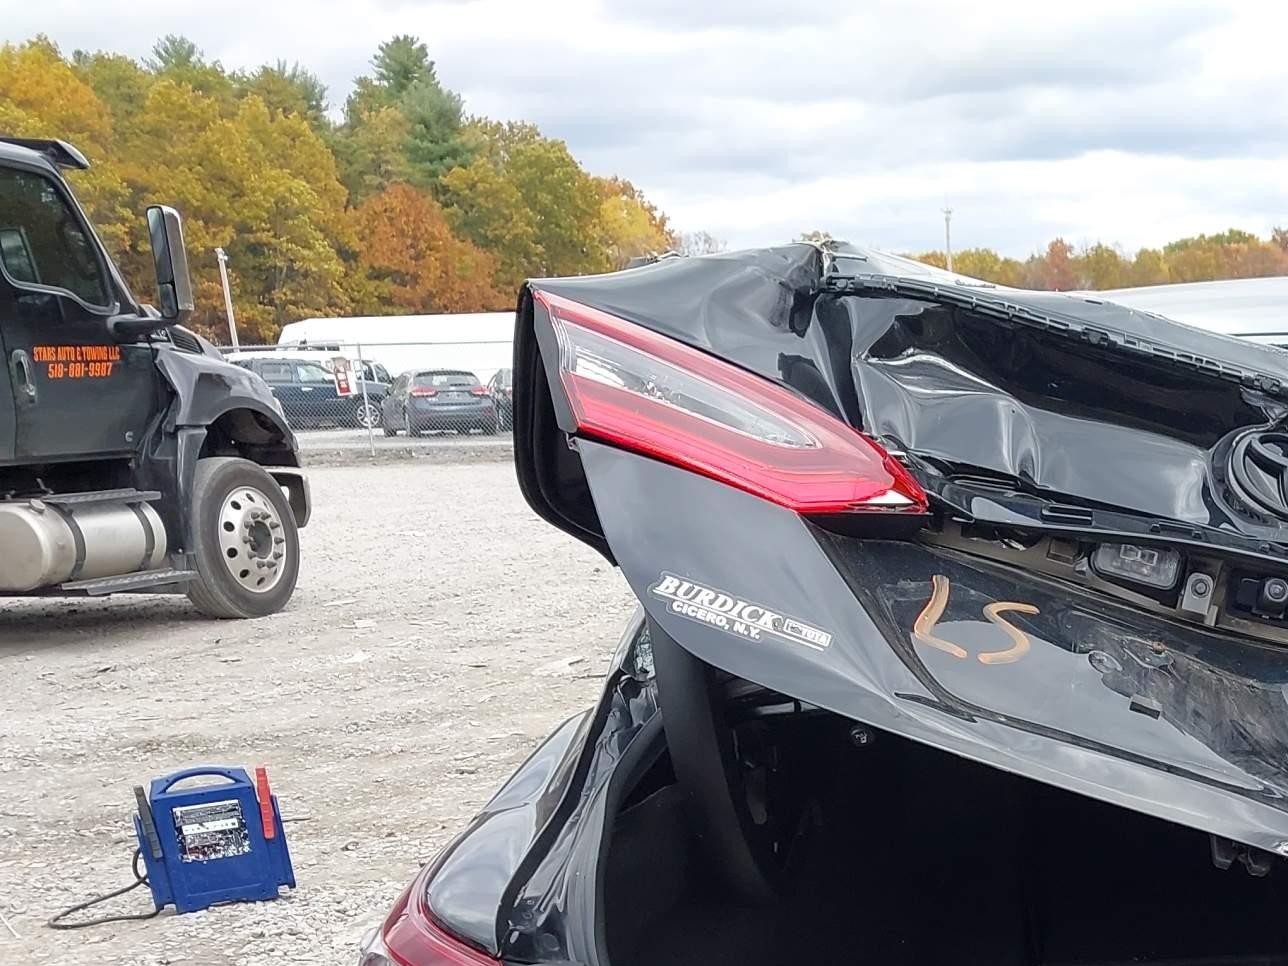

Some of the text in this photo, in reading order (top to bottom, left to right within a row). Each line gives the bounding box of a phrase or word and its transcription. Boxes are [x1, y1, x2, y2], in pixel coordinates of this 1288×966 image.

[57, 346, 75, 361] AUTO
[82, 346, 108, 361] TOWING
[108, 346, 120, 360] LLC
[656, 575, 783, 631] BURDICK
[672, 601, 761, 640] CICERO, N.Y.
